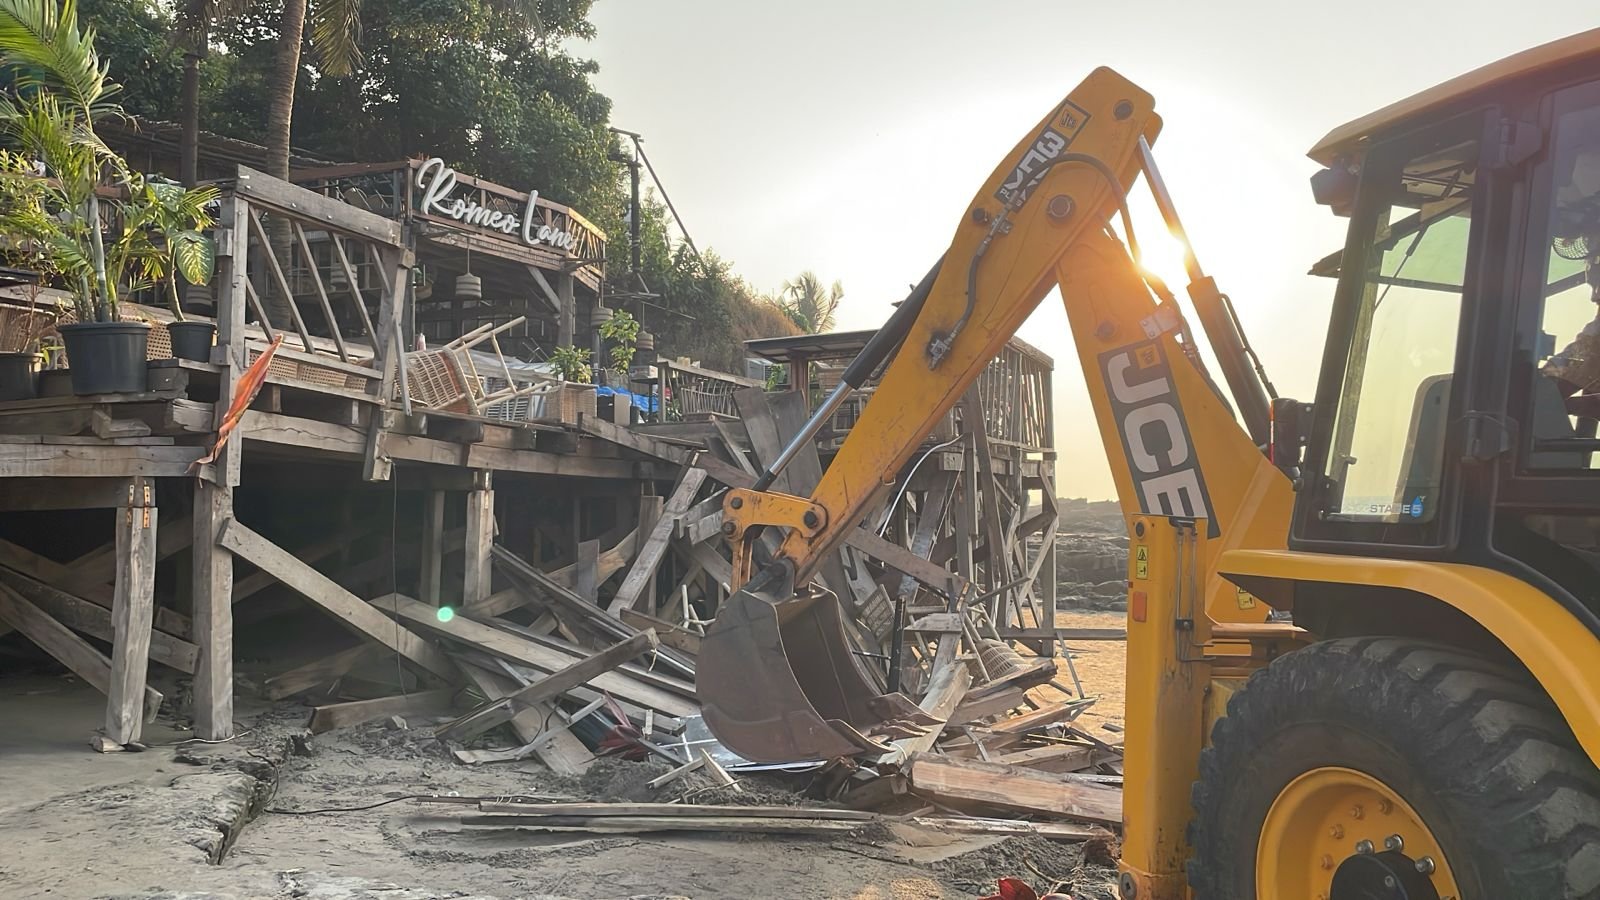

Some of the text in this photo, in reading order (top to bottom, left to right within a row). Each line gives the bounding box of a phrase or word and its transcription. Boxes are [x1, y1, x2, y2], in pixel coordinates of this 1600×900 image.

[415, 157, 574, 249] Romeo Lane
[1000, 187, 1023, 206] PLS
[1412, 504, 1421, 514] 5
